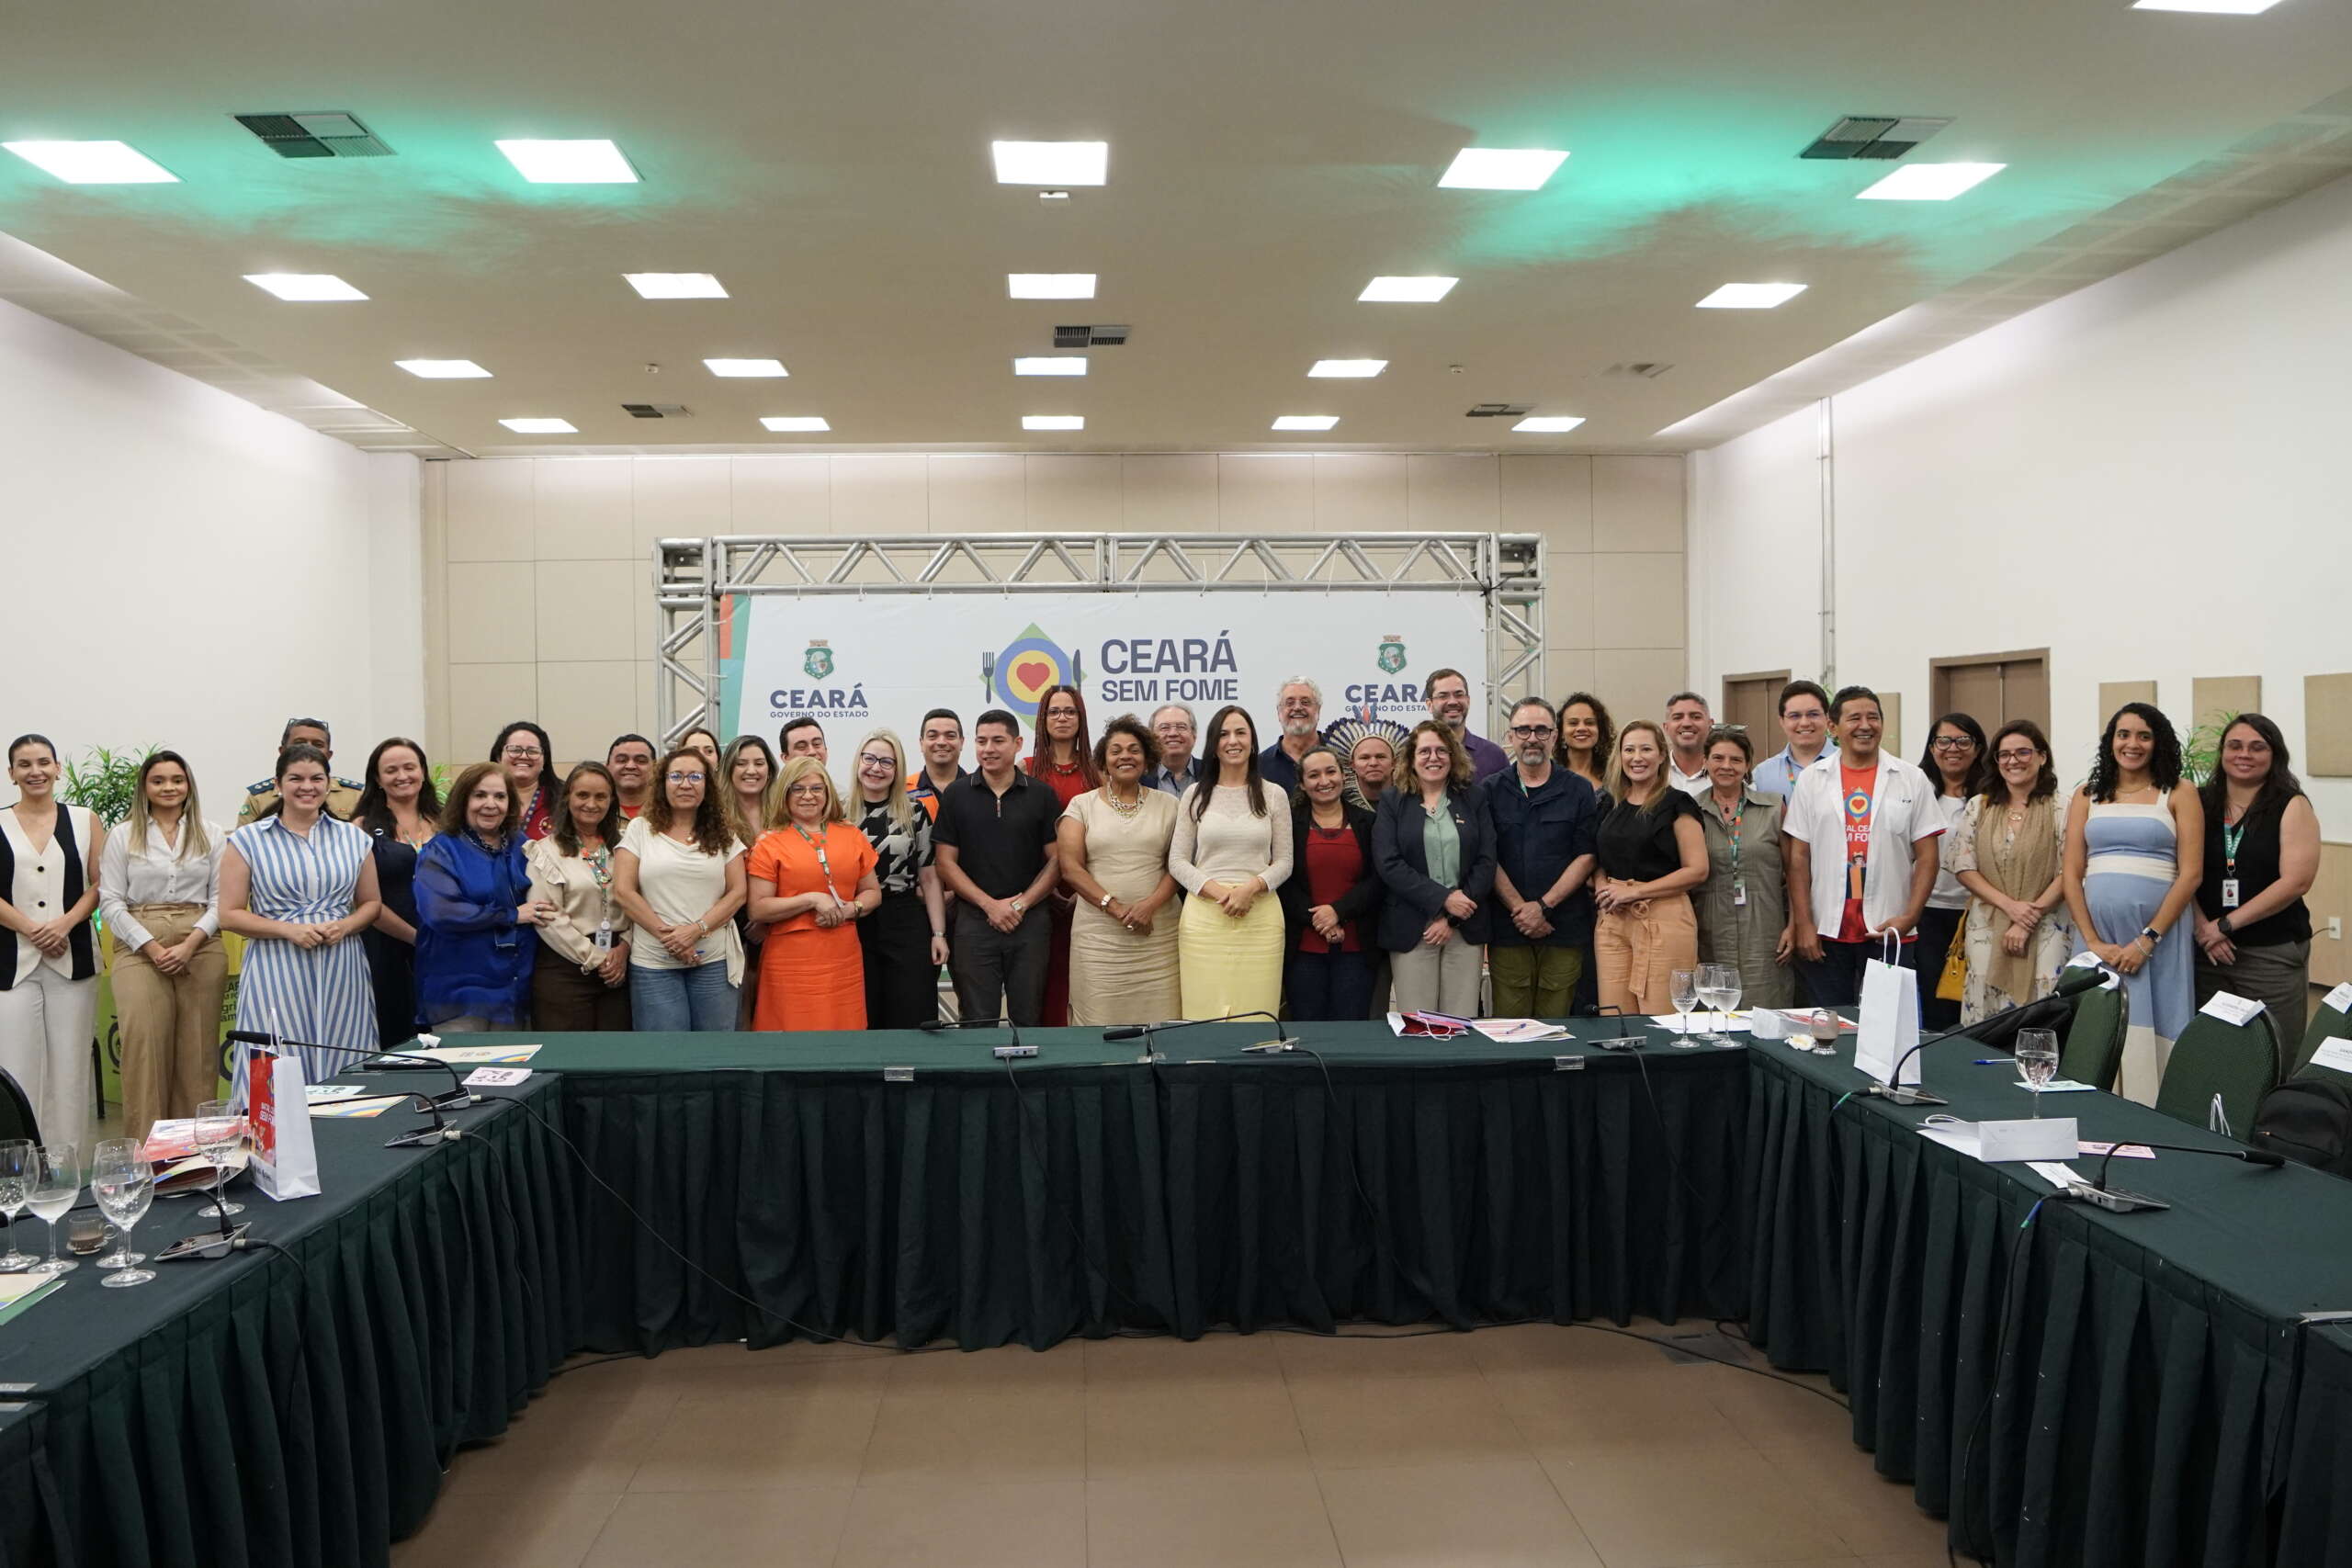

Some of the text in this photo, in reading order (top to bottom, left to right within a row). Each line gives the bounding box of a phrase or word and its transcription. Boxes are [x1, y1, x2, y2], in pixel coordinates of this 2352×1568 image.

[1101, 629, 1238, 674] CEARÁ
[770, 682, 868, 709] CEARÁ
[1102, 679, 1238, 702] SEM FOME
[1344, 683, 1428, 704] CEAR
